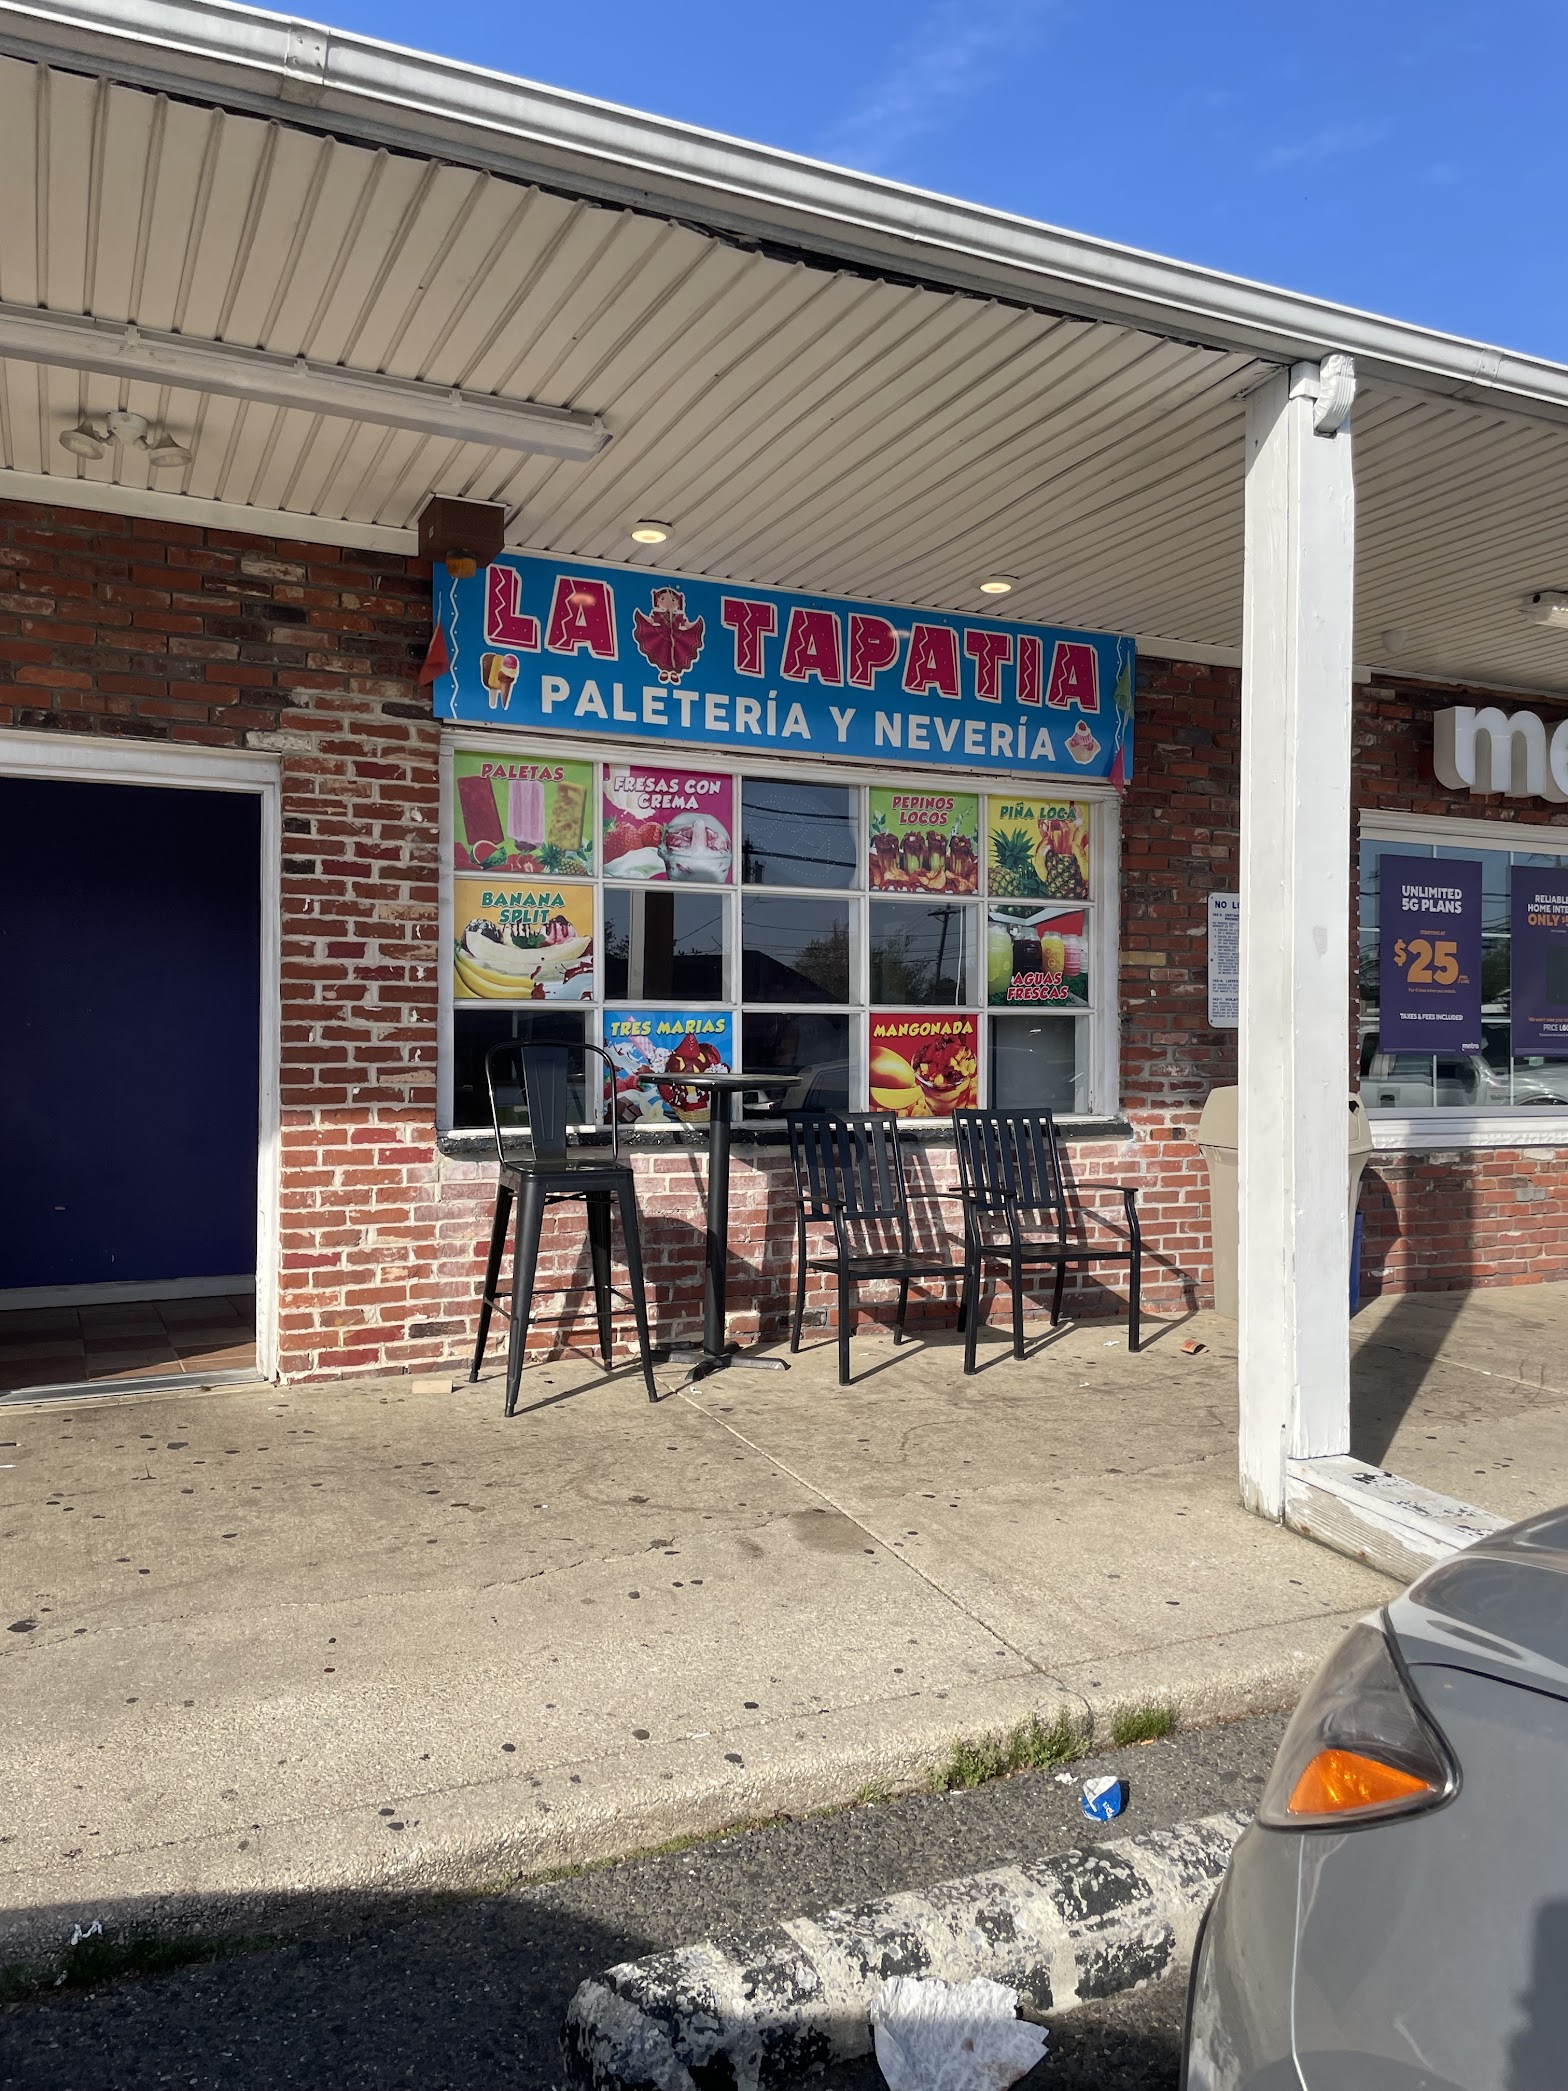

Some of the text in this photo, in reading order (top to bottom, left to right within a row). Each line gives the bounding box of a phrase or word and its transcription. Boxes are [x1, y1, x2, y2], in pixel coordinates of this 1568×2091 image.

[484, 563, 1100, 714] LA TAPATIA
[541, 675, 1056, 762] PALETERÍA Y NEVERÍA
[480, 763, 565, 782] PALETAS
[614, 776, 721, 795] FRESAS CON
[637, 793, 699, 810] CREMA
[892, 796, 954, 811] PEPINOS
[899, 811, 948, 826] LOCOS
[999, 802, 1077, 821] PIÑA LOCA
[480, 891, 565, 908] BANANA
[1402, 885, 1462, 900] UNLIMITED
[1215, 901, 1227, 909] NO
[1402, 898, 1462, 914] 5G PLANS
[1527, 903, 1551, 913] HOME
[499, 909, 550, 924] SPLIT
[1528, 913, 1560, 927] ONLY
[1394, 938, 1459, 985] $25
[1012, 971, 1063, 986] AGUAS
[1007, 986, 1069, 1001] FRESCAS
[610, 1018, 726, 1037] TRES MARIAS
[873, 1021, 974, 1039] MANGONADA
[1543, 1023, 1559, 1032] PRICE
